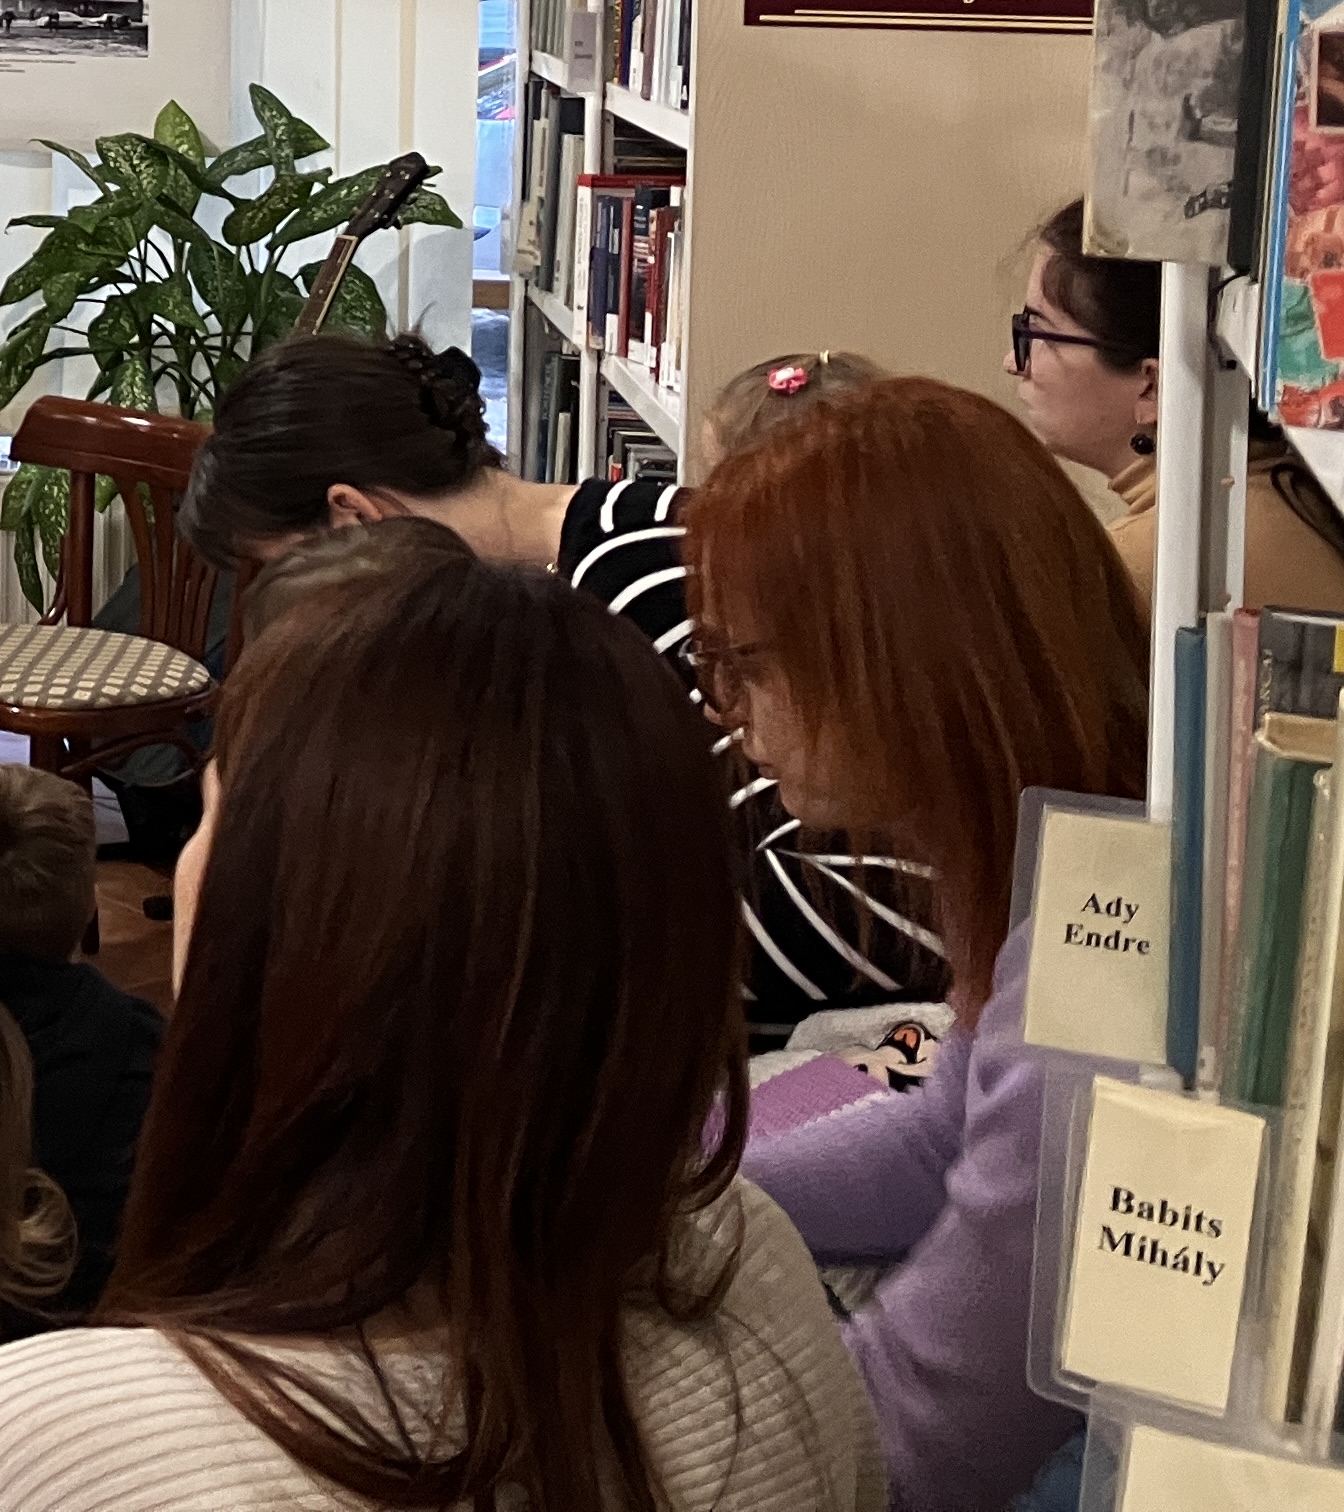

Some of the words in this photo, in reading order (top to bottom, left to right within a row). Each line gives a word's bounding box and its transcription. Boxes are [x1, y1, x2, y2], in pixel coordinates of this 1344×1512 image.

[1080, 893, 1140, 924] Ady
[1064, 923, 1150, 955] Endre
[1109, 1184, 1224, 1239] Babits
[1098, 1224, 1226, 1287] Mihály
